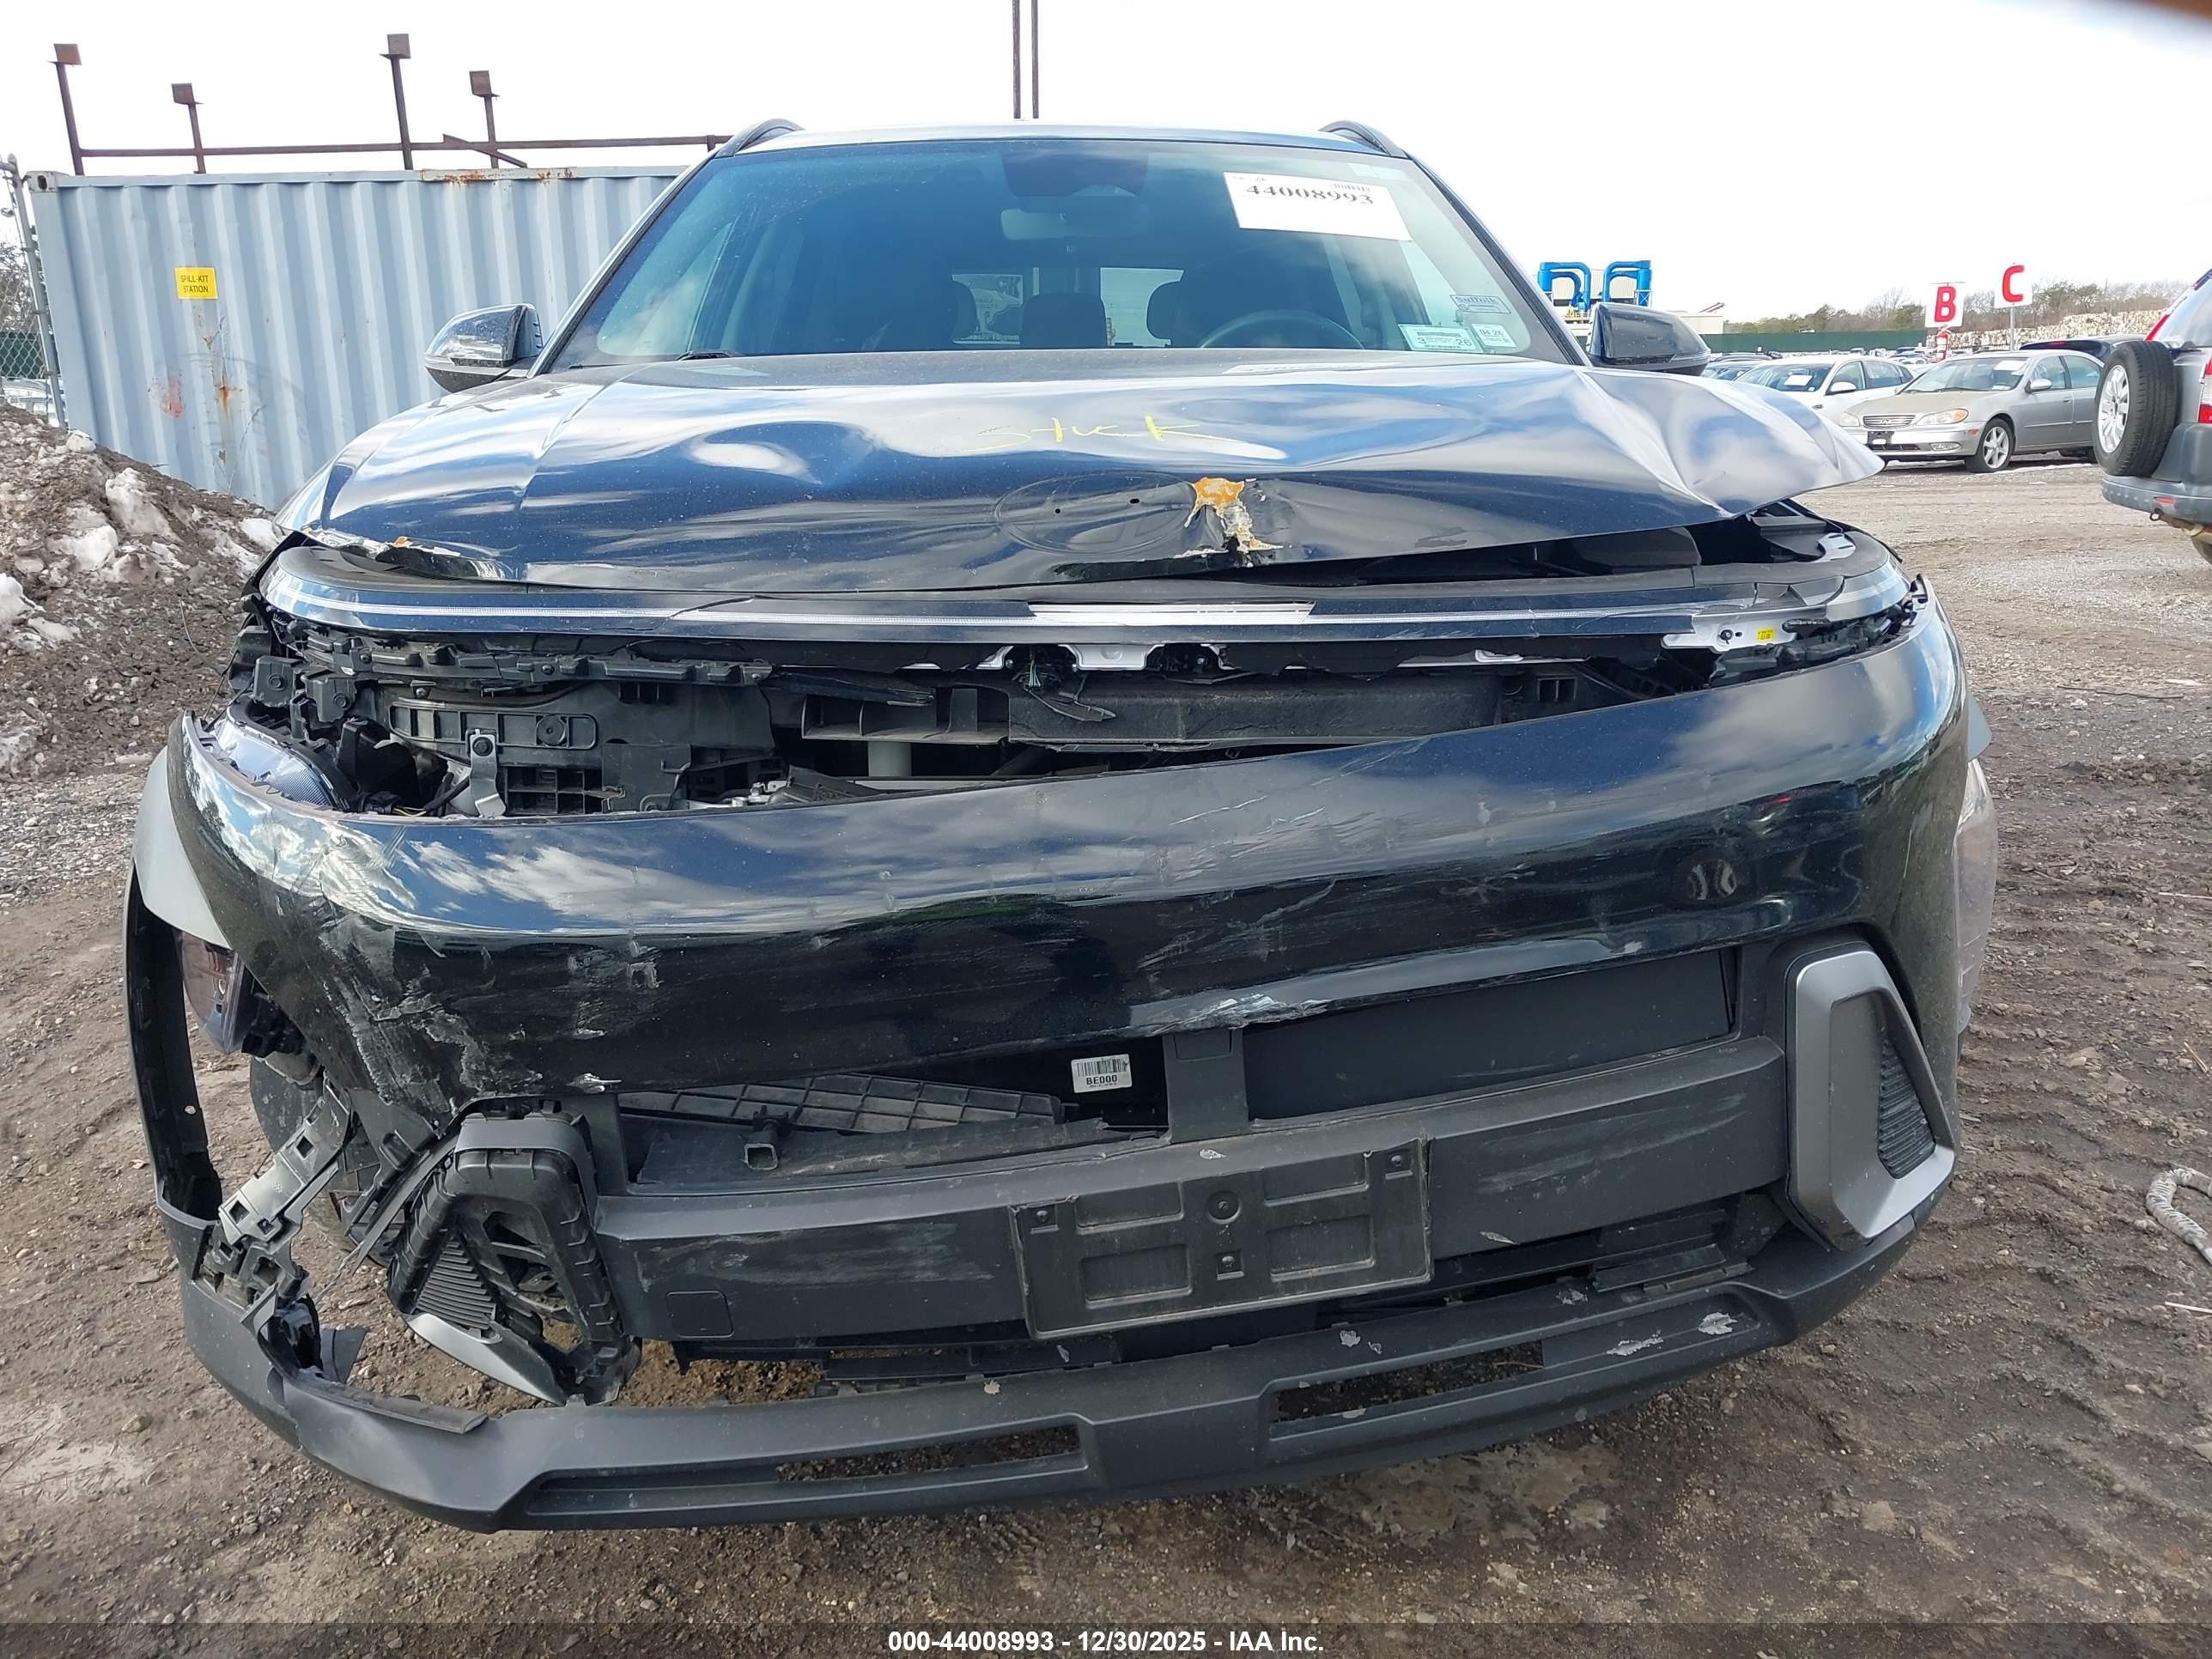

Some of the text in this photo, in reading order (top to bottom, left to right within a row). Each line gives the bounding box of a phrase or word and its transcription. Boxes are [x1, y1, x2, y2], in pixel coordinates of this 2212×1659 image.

[1246, 185, 1374, 205] 44008993
[2002, 264, 2025, 302] C
[1934, 286, 1956, 323] B
